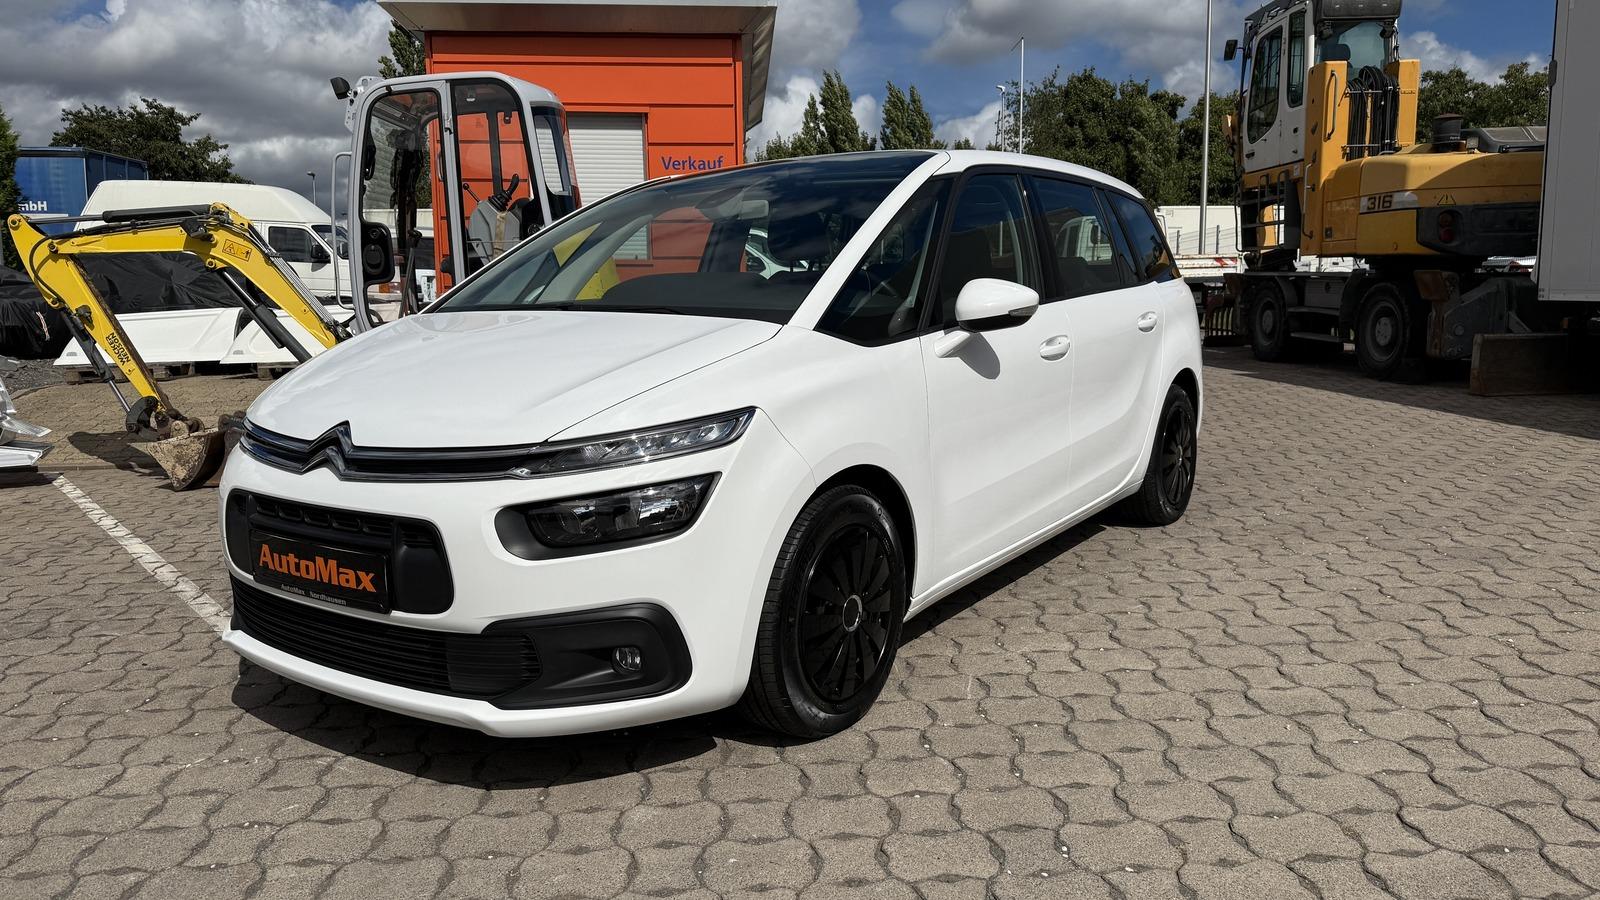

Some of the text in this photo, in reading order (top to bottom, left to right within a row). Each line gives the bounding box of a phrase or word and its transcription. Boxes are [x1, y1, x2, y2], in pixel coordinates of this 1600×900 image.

[661, 155, 724, 171] Verkauf
[1366, 194, 1394, 211] 316
[105, 334, 127, 366] WACKER
[110, 332, 132, 363] NEUSON
[259, 543, 377, 593] AutoMax
[280, 583, 347, 606] AutoMax Nordhausen
